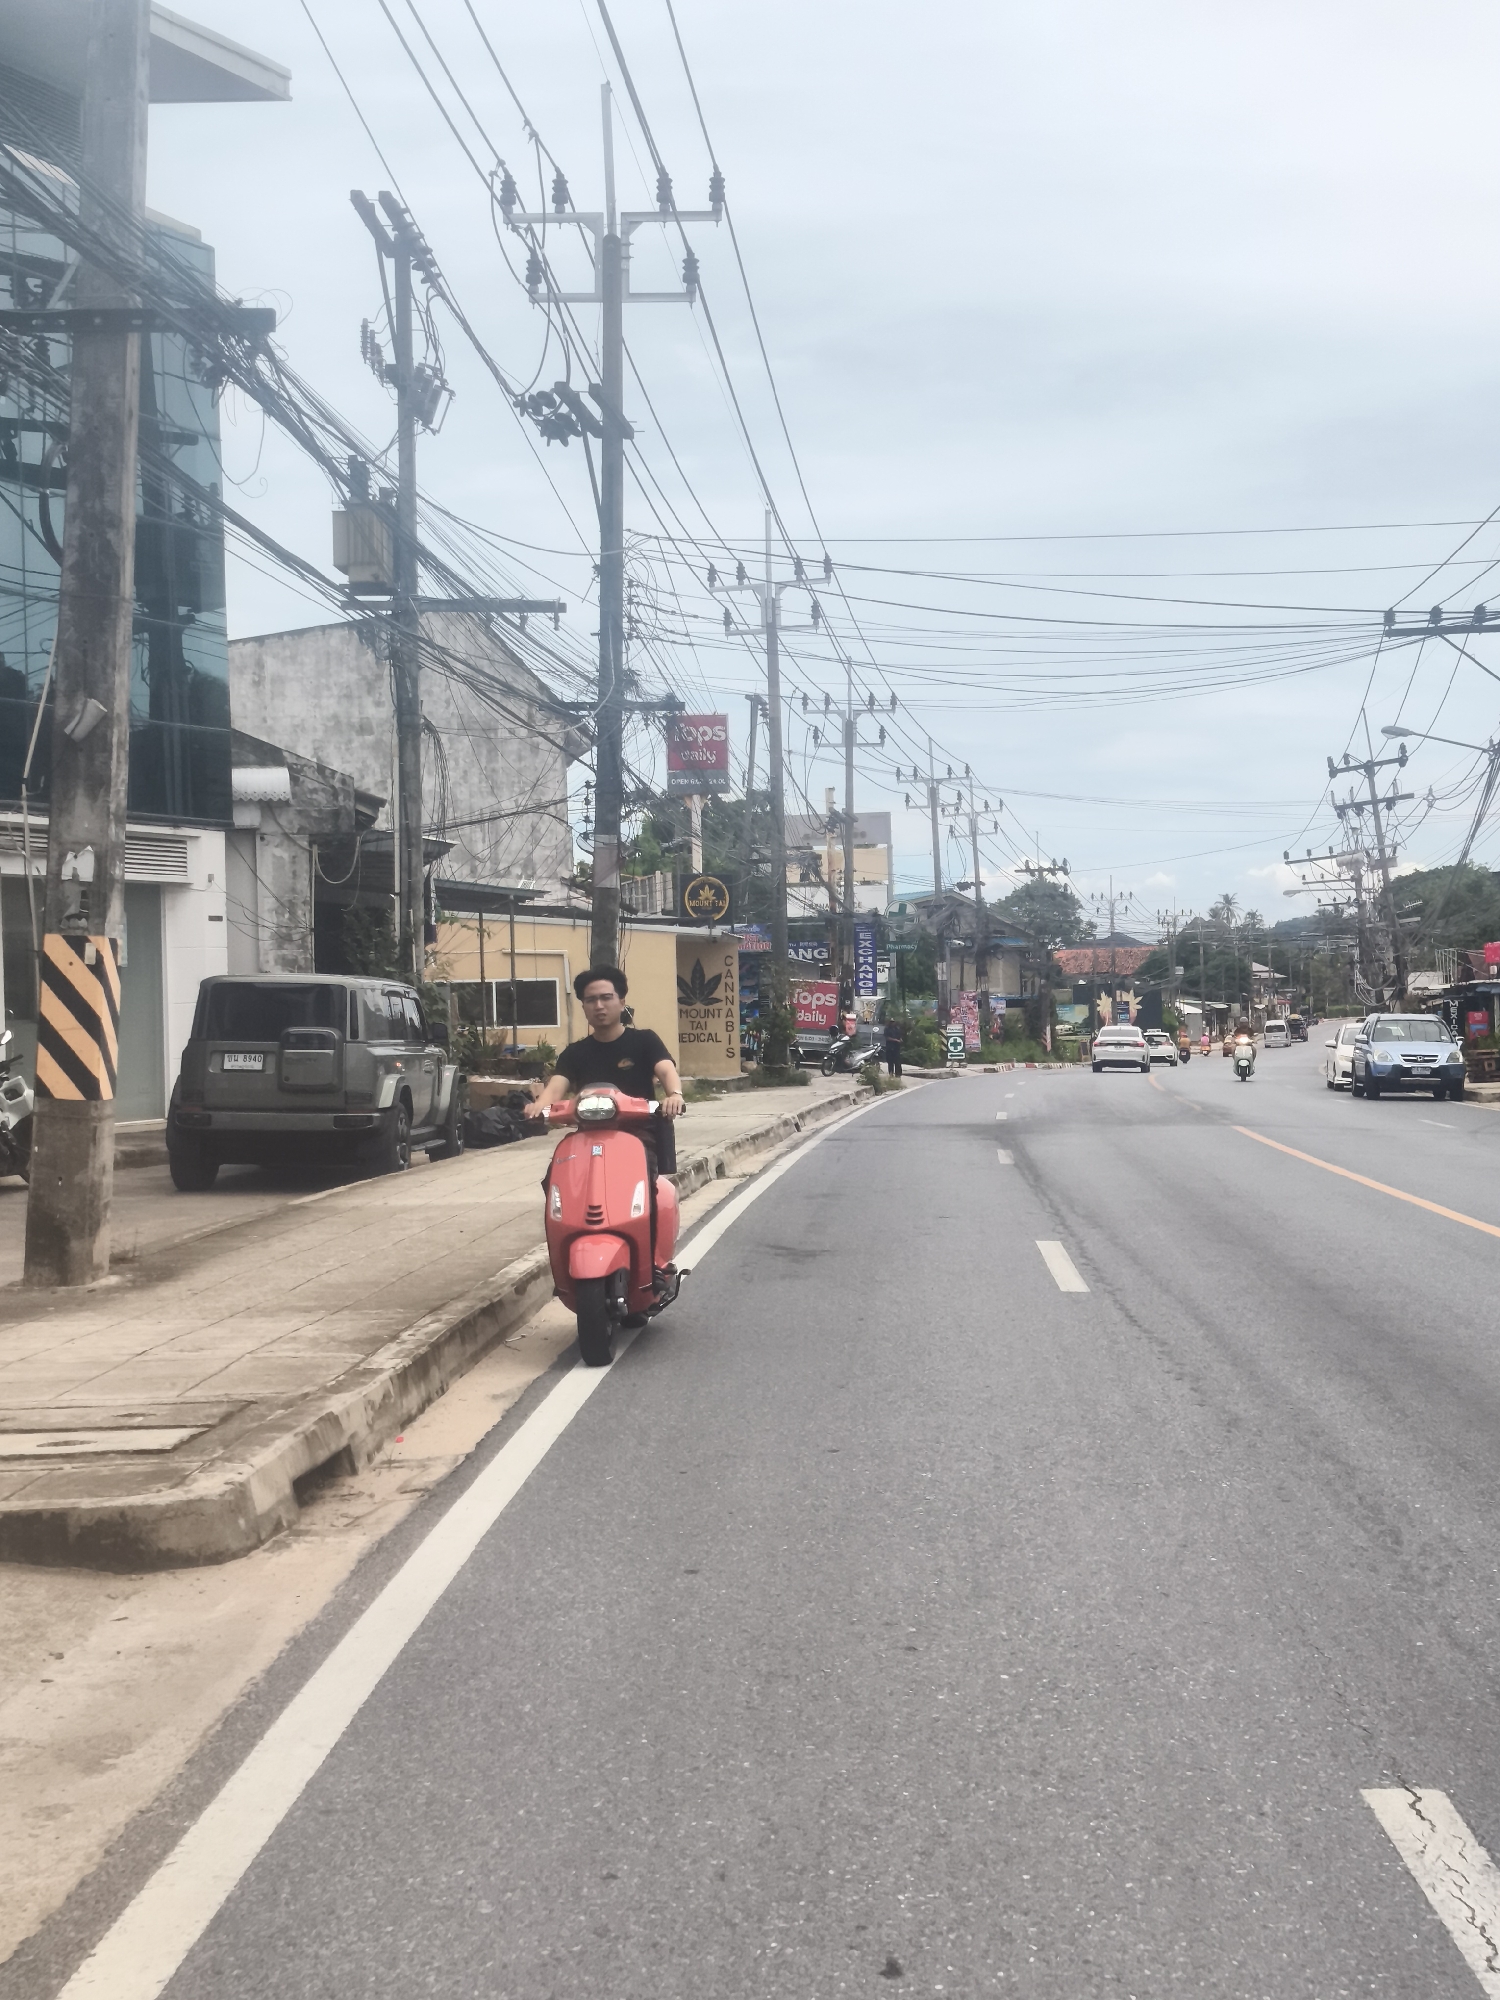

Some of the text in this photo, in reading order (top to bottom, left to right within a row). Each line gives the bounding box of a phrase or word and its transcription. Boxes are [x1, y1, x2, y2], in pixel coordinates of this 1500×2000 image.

[886, 943, 918, 951] Pharmacy
[858, 932, 873, 995] EXCHANGE
[793, 988, 836, 1009] Tops
[679, 1008, 722, 1019] MOUNT
[724, 955, 735, 1058] CANNABIS
[797, 1010, 826, 1024] daily
[689, 1020, 708, 1031] TAI
